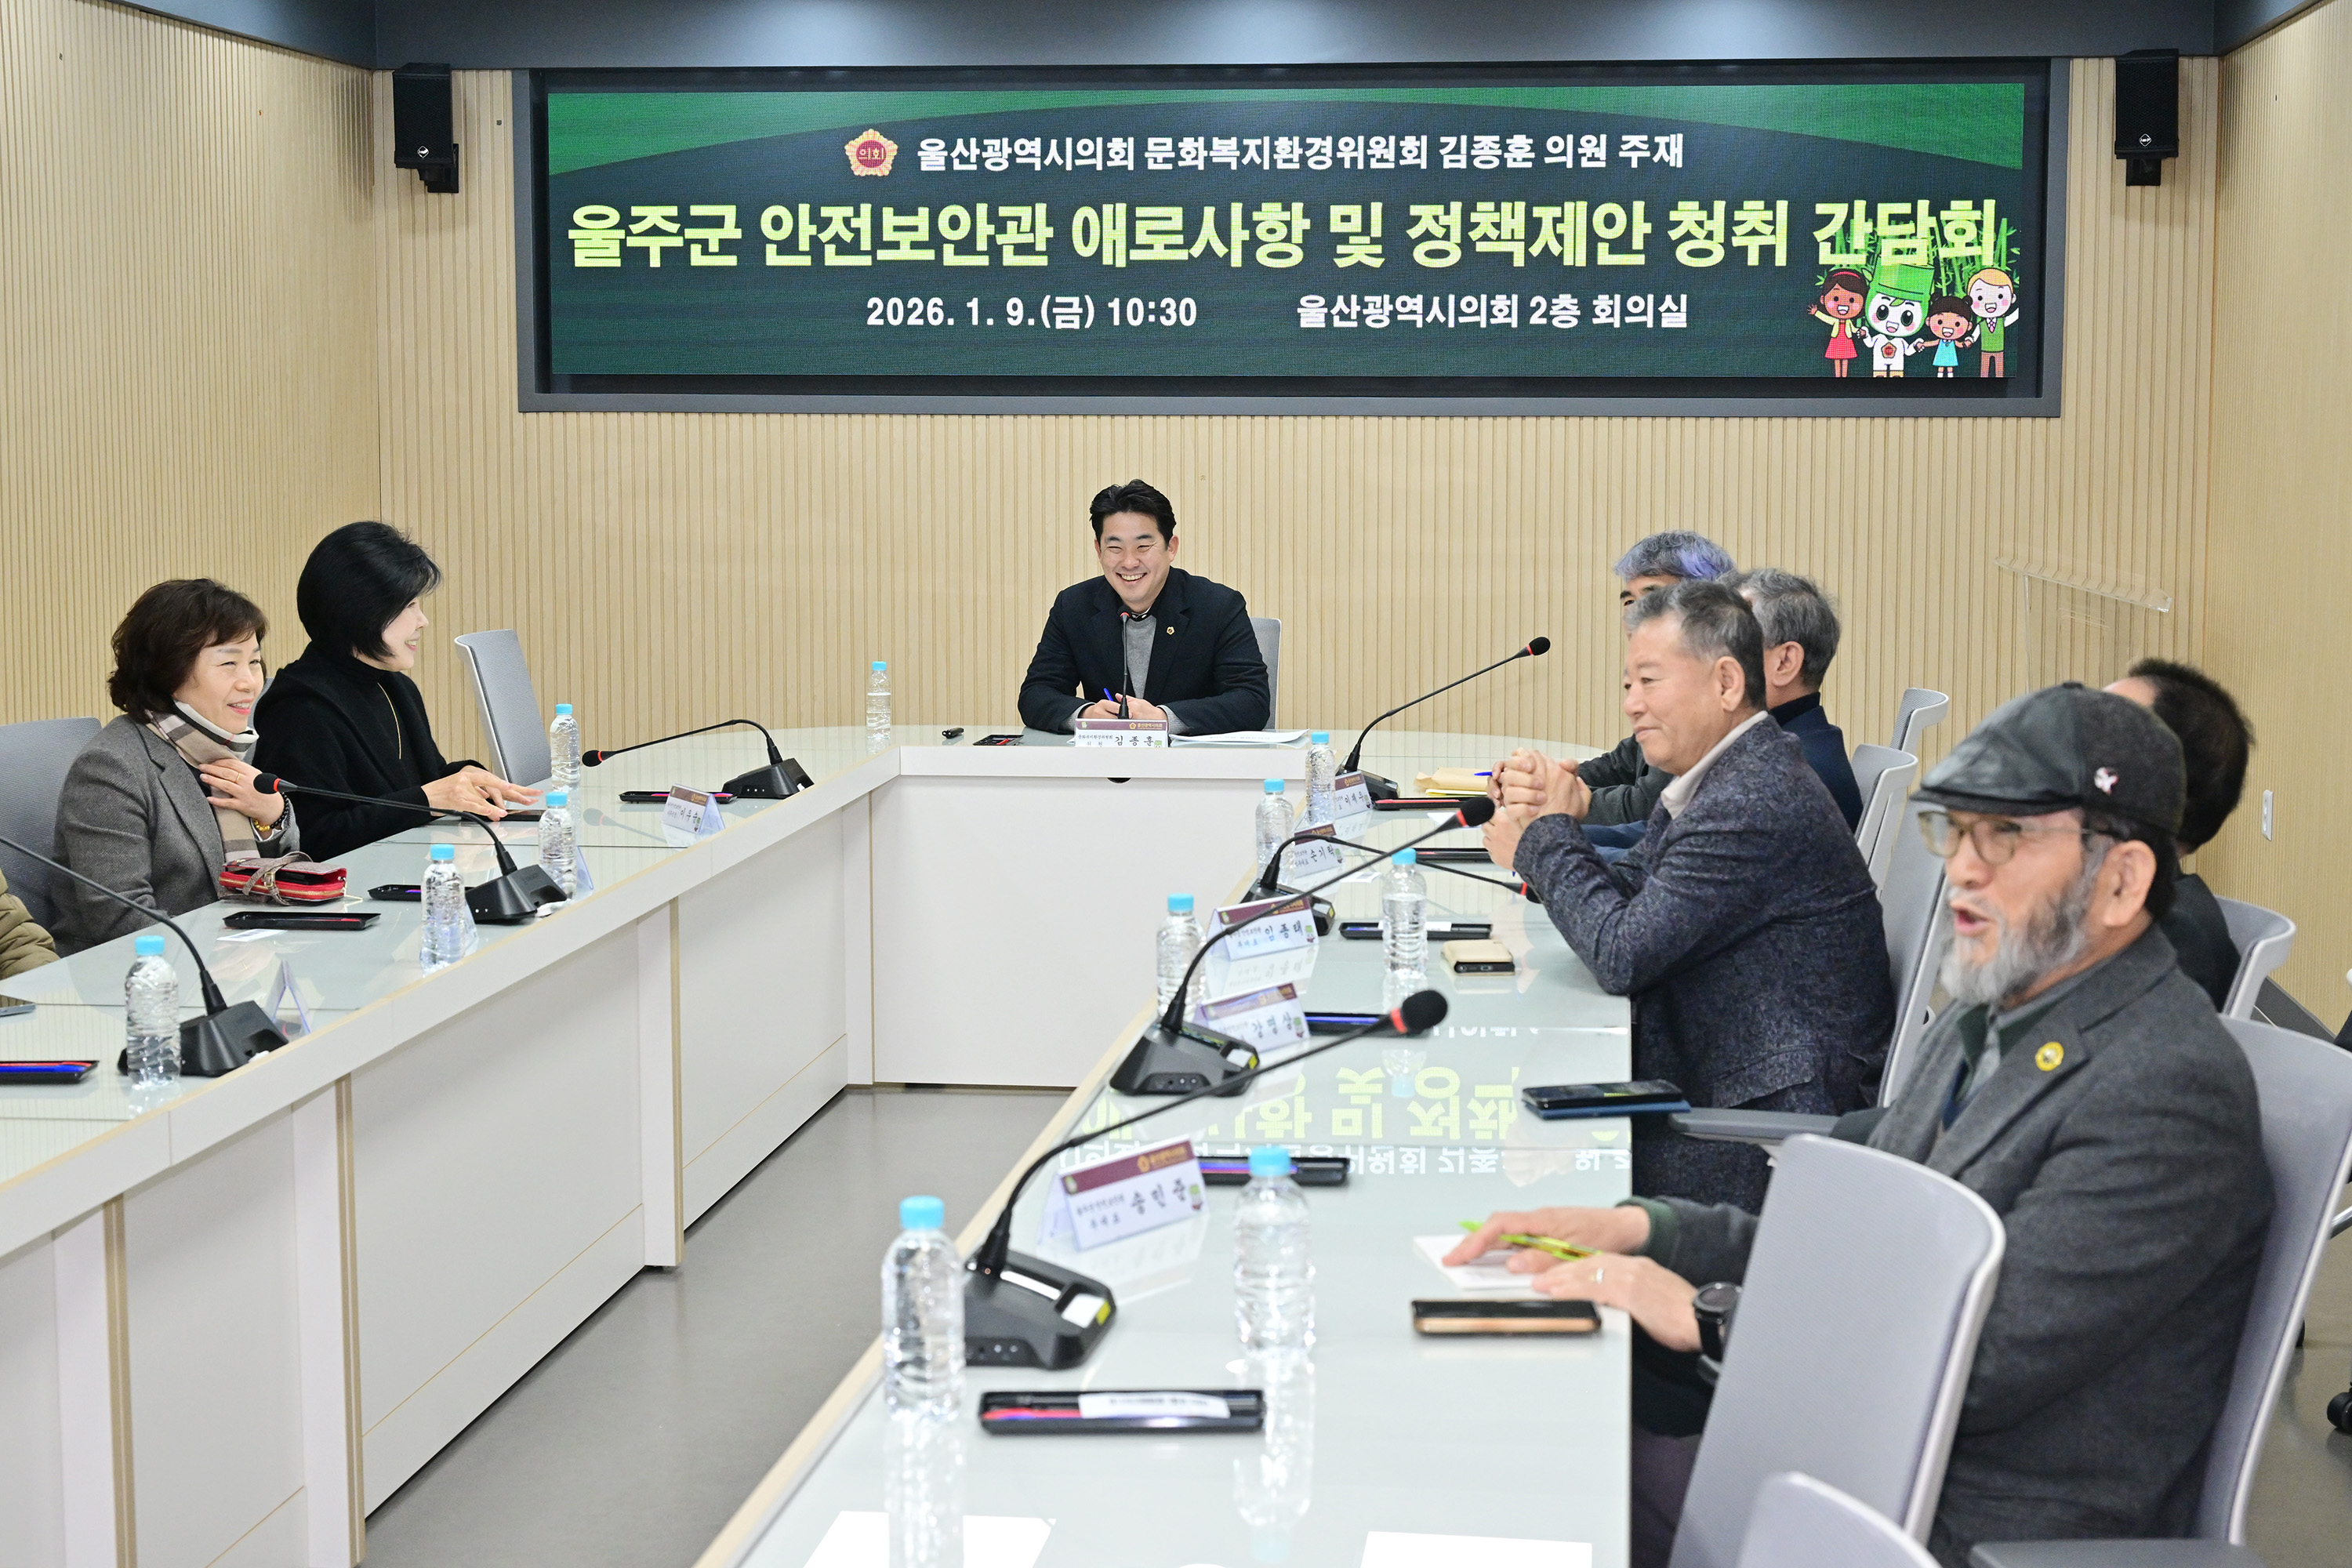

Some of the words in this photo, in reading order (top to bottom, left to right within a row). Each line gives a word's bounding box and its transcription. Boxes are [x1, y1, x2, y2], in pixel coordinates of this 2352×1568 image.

[858, 147, 884, 160] 의회
[918, 137, 1135, 172] 울산광역시의회
[1145, 136, 1428, 171] 문화복지환경위원회
[1439, 135, 1537, 170] 김종훈
[1544, 134, 1608, 169] 의원
[1619, 133, 1684, 169] 주재
[568, 205, 743, 269] 울주군
[761, 203, 1054, 267] 안전보안관
[1073, 202, 1312, 269] 애로사항
[1329, 202, 1386, 269] 및
[1406, 201, 1653, 269] 정책제안
[1668, 200, 1789, 268] 청취
[1813, 199, 1996, 268] 간담회
[866, 297, 955, 327] 2026.
[967, 298, 995, 327] 1.
[1007, 295, 1095, 330] 9.(금)
[1108, 298, 1198, 328] 10:30
[1298, 294, 1519, 329] 울산광역시의회
[1530, 294, 1582, 330] 2층
[1592, 294, 1688, 329] 회의실
[1115, 735, 1154, 746] 김종훈
